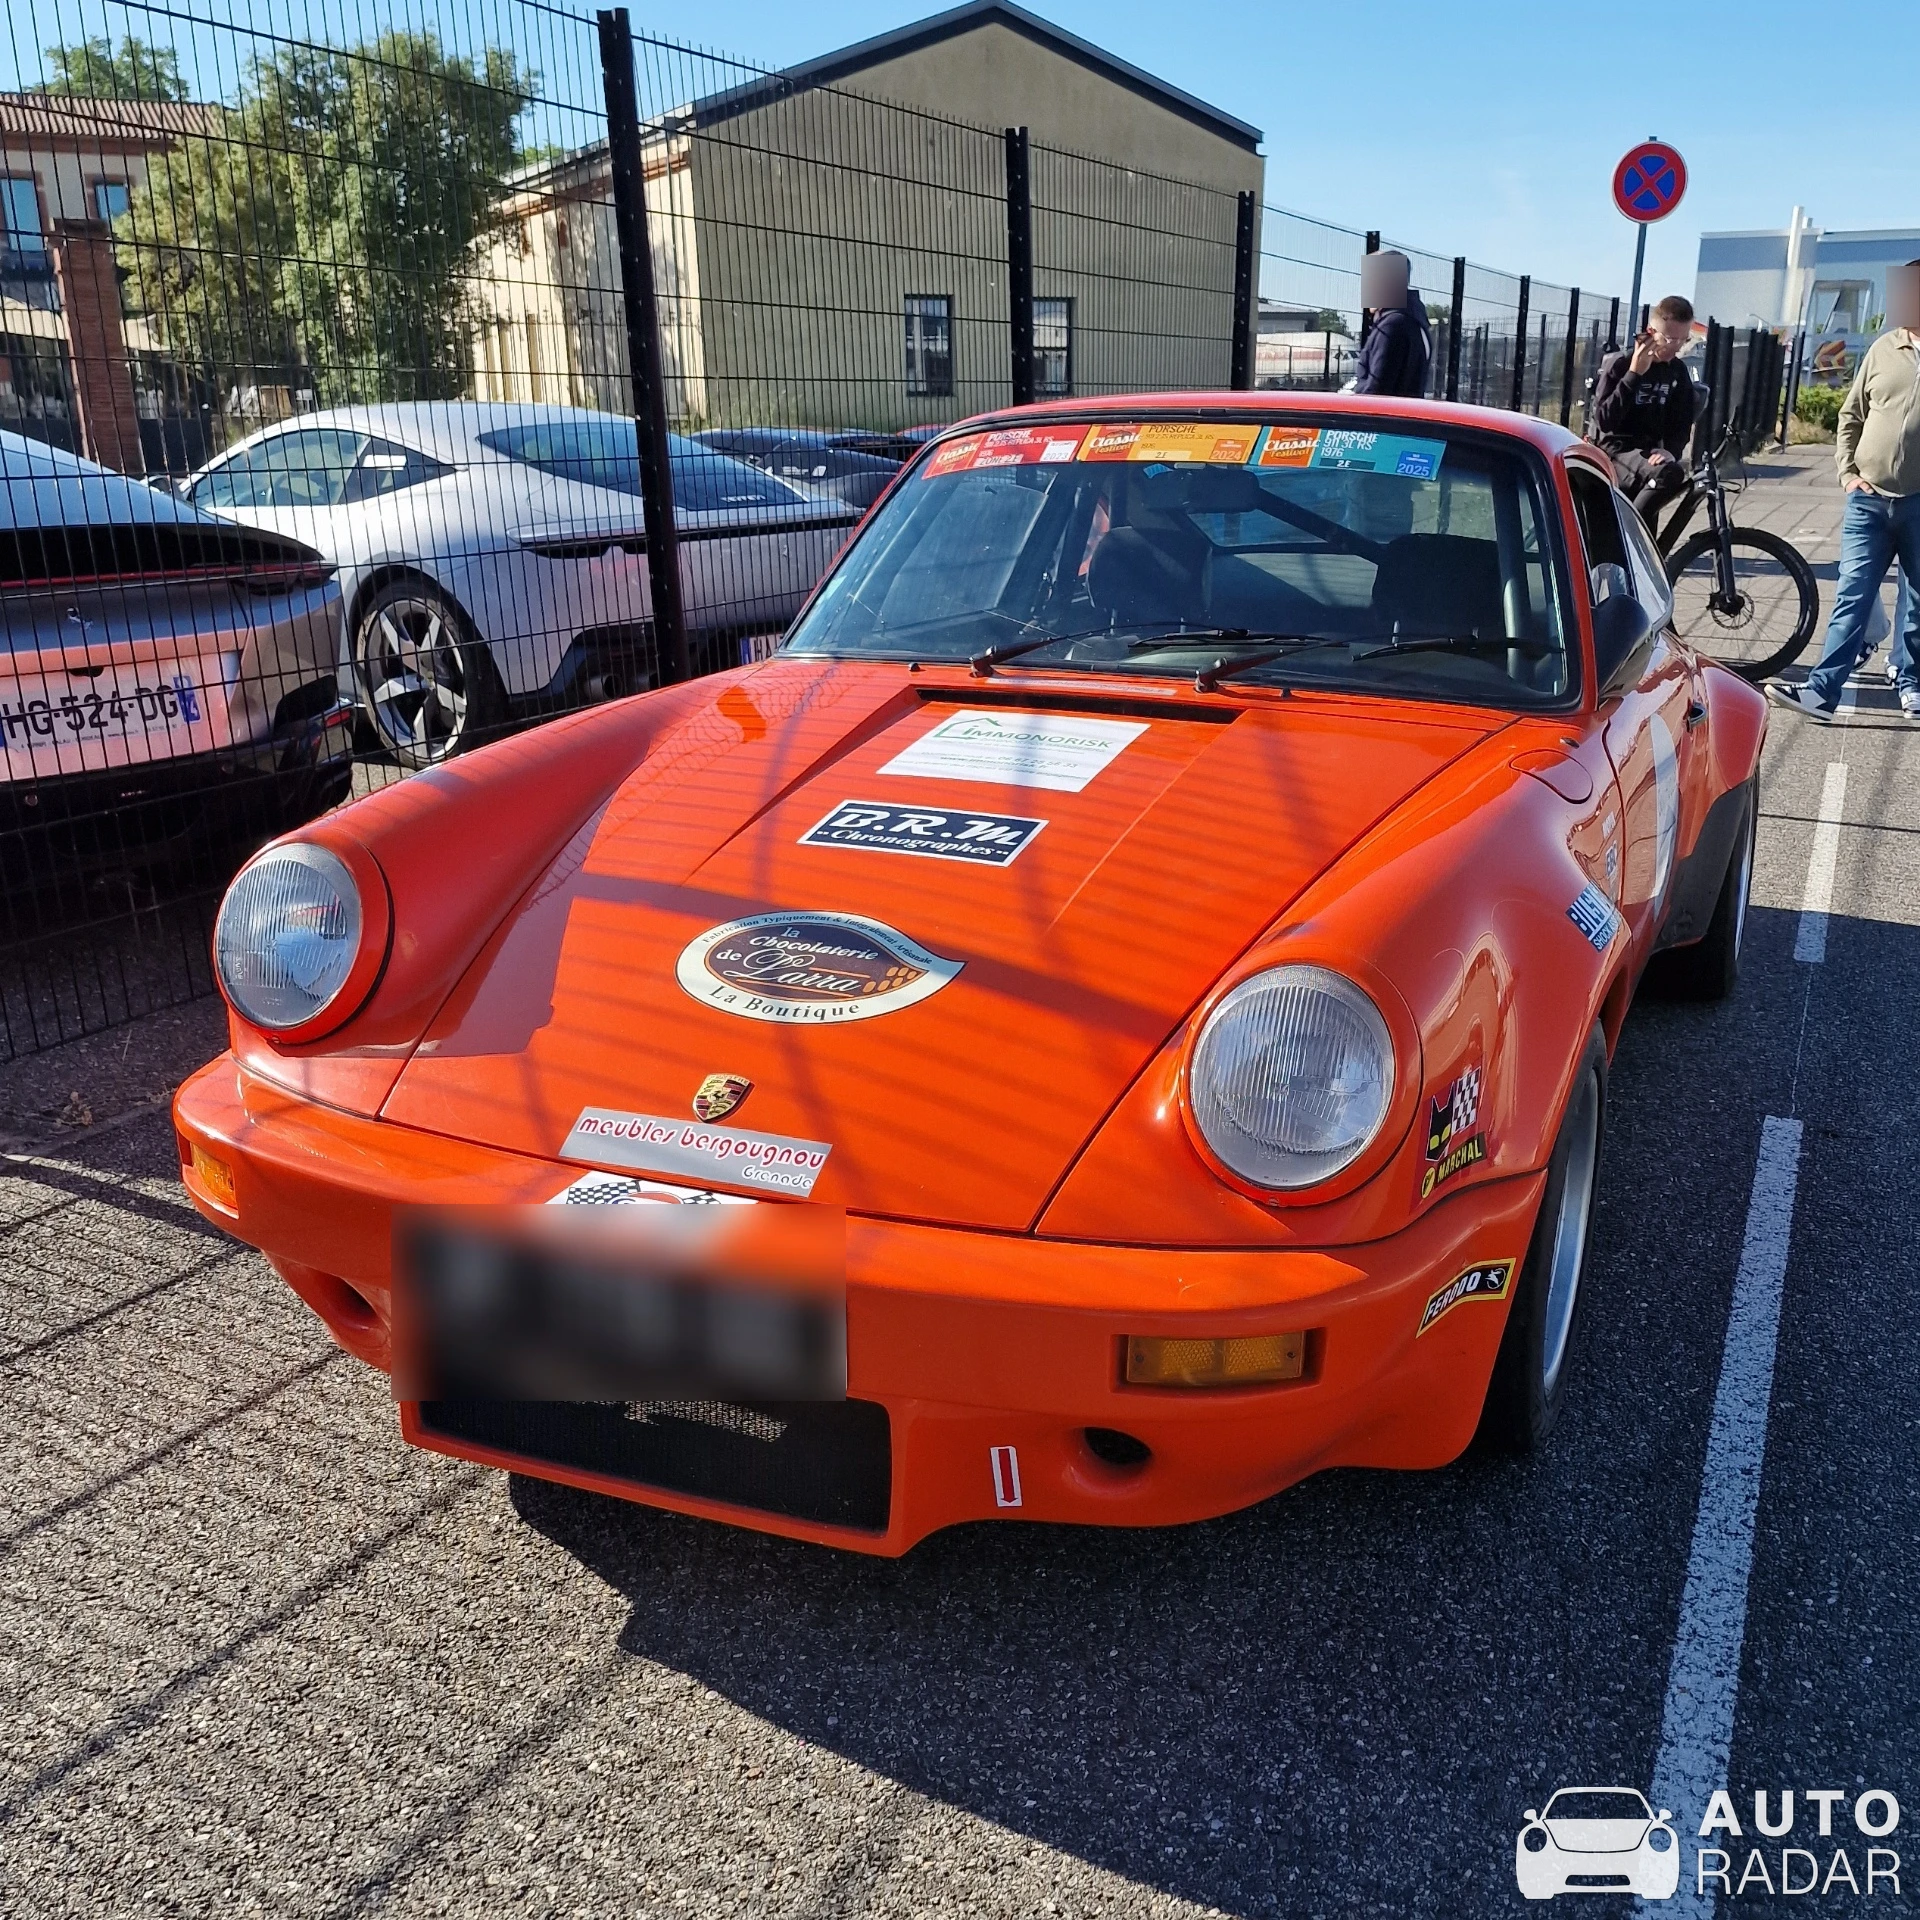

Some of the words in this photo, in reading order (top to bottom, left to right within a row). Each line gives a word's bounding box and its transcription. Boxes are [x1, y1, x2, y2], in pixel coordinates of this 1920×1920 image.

[987, 430, 1033, 442] PORSCHE
[1148, 425, 1198, 434] PORSCHE
[1325, 430, 1380, 442] PORSCHE
[1089, 432, 1141, 449] Classic
[1264, 437, 1320, 451] Classic
[1323, 438, 1340, 448] 911
[1356, 441, 1374, 451] RS
[936, 442, 981, 463] Classic
[1212, 450, 1241, 460] 2024
[1320, 448, 1345, 457] 1976
[1397, 463, 1431, 477] 2025
[830, 829, 996, 856] Chronographes
[701, 919, 759, 943] Fabrication
[761, 915, 832, 924] Typiquement
[844, 917, 899, 945] Intégralement
[894, 944, 933, 965] Artisanale
[781, 926, 800, 938] la
[716, 949, 742, 961] de
[749, 936, 879, 960] Chocolaterie
[723, 948, 861, 992] Larra
[709, 985, 737, 1004] La
[744, 997, 861, 1021] Boutique
[578, 1117, 677, 1145] meubles
[680, 1127, 827, 1169] bergougnou
[1438, 1139, 1482, 1183] MARCHAL
[742, 1165, 813, 1189] Grenade
[1424, 1271, 1482, 1325] FERODO
